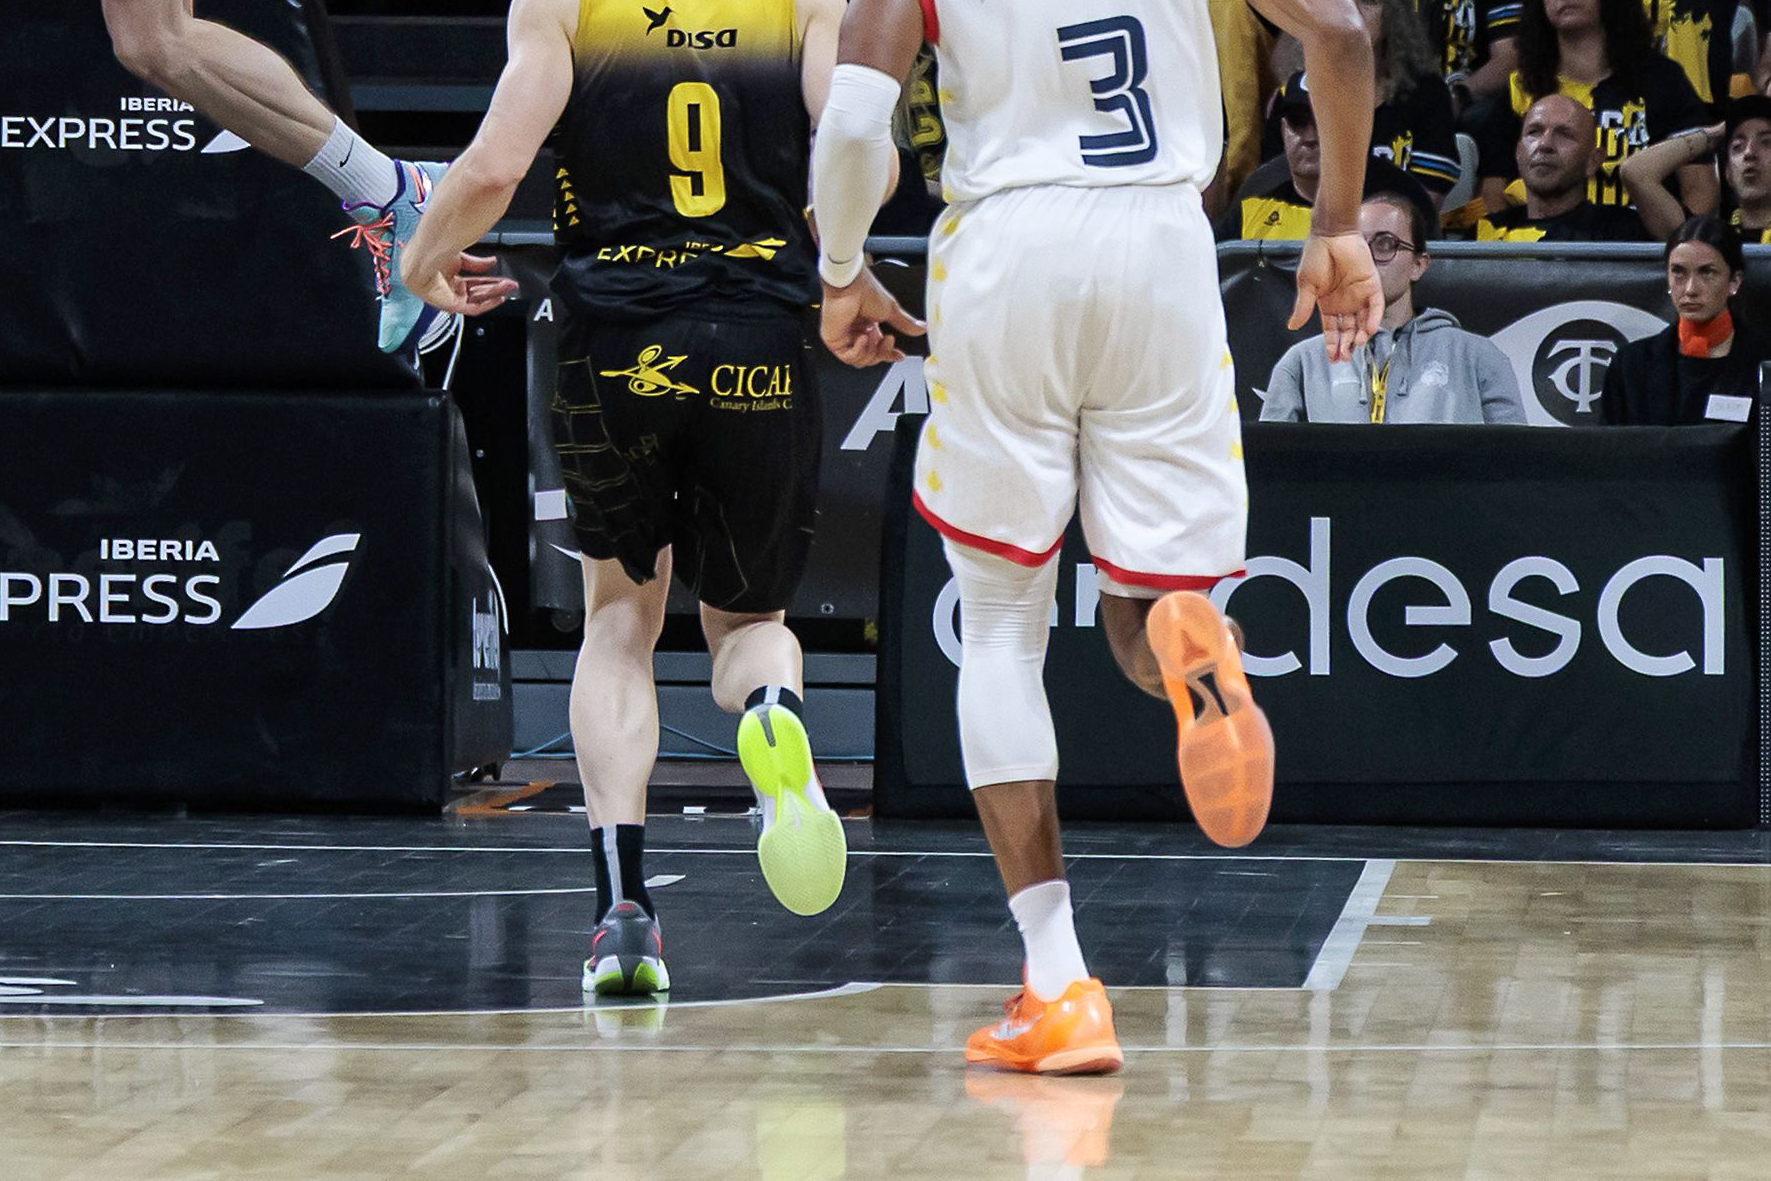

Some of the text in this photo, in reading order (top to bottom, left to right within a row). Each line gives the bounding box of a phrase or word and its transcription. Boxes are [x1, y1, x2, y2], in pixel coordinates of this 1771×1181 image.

[120, 97, 195, 112] IBERIA
[1056, 15, 1158, 167] 3
[1, 116, 196, 151] EXPRESS
[666, 82, 726, 218] 9
[100, 538, 220, 562] IBERIA
